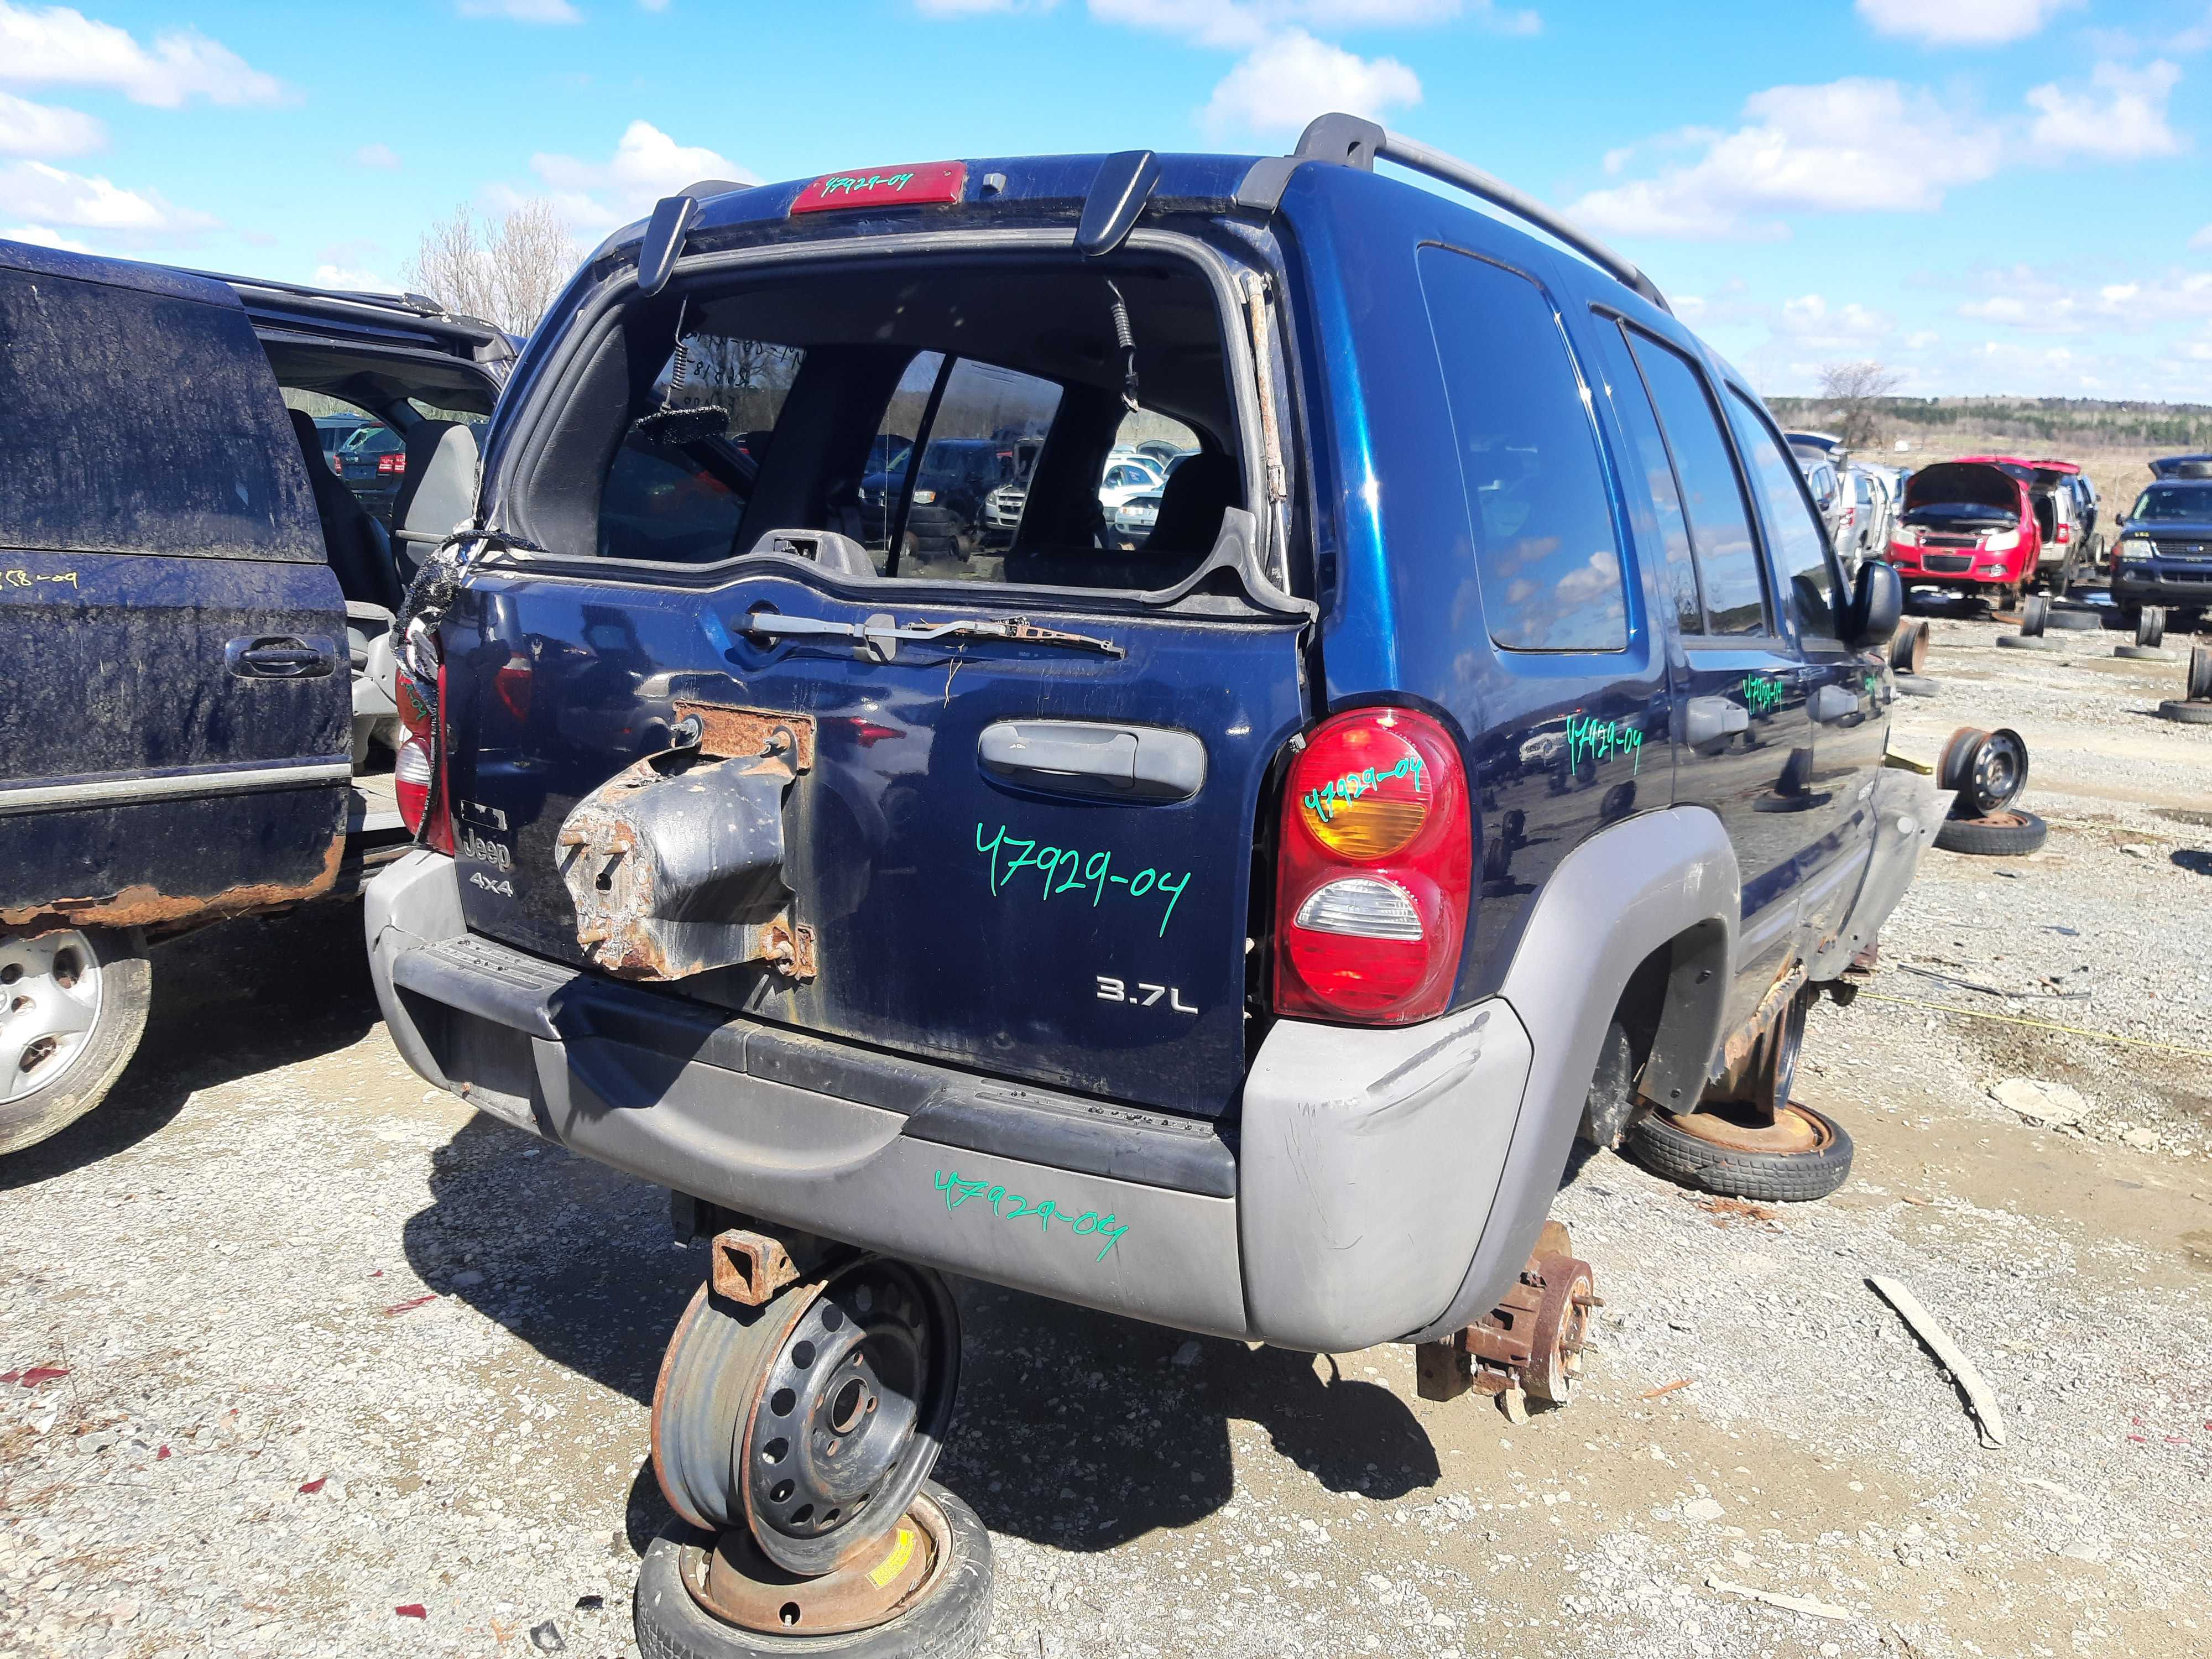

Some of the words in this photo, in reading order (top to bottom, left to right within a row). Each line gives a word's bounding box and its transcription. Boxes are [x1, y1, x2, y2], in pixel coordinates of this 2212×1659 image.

[821, 173, 914, 198] 47929-04
[0, 569, 79, 591] 58-09
[1567, 715, 1642, 776] 47929-04
[1304, 757, 1424, 823] 47929-04
[463, 827, 511, 873] Jeep
[976, 822, 1192, 938] 47929-04
[1096, 975, 1199, 1015] 3.7L
[934, 1170, 1129, 1263] 47929-04
